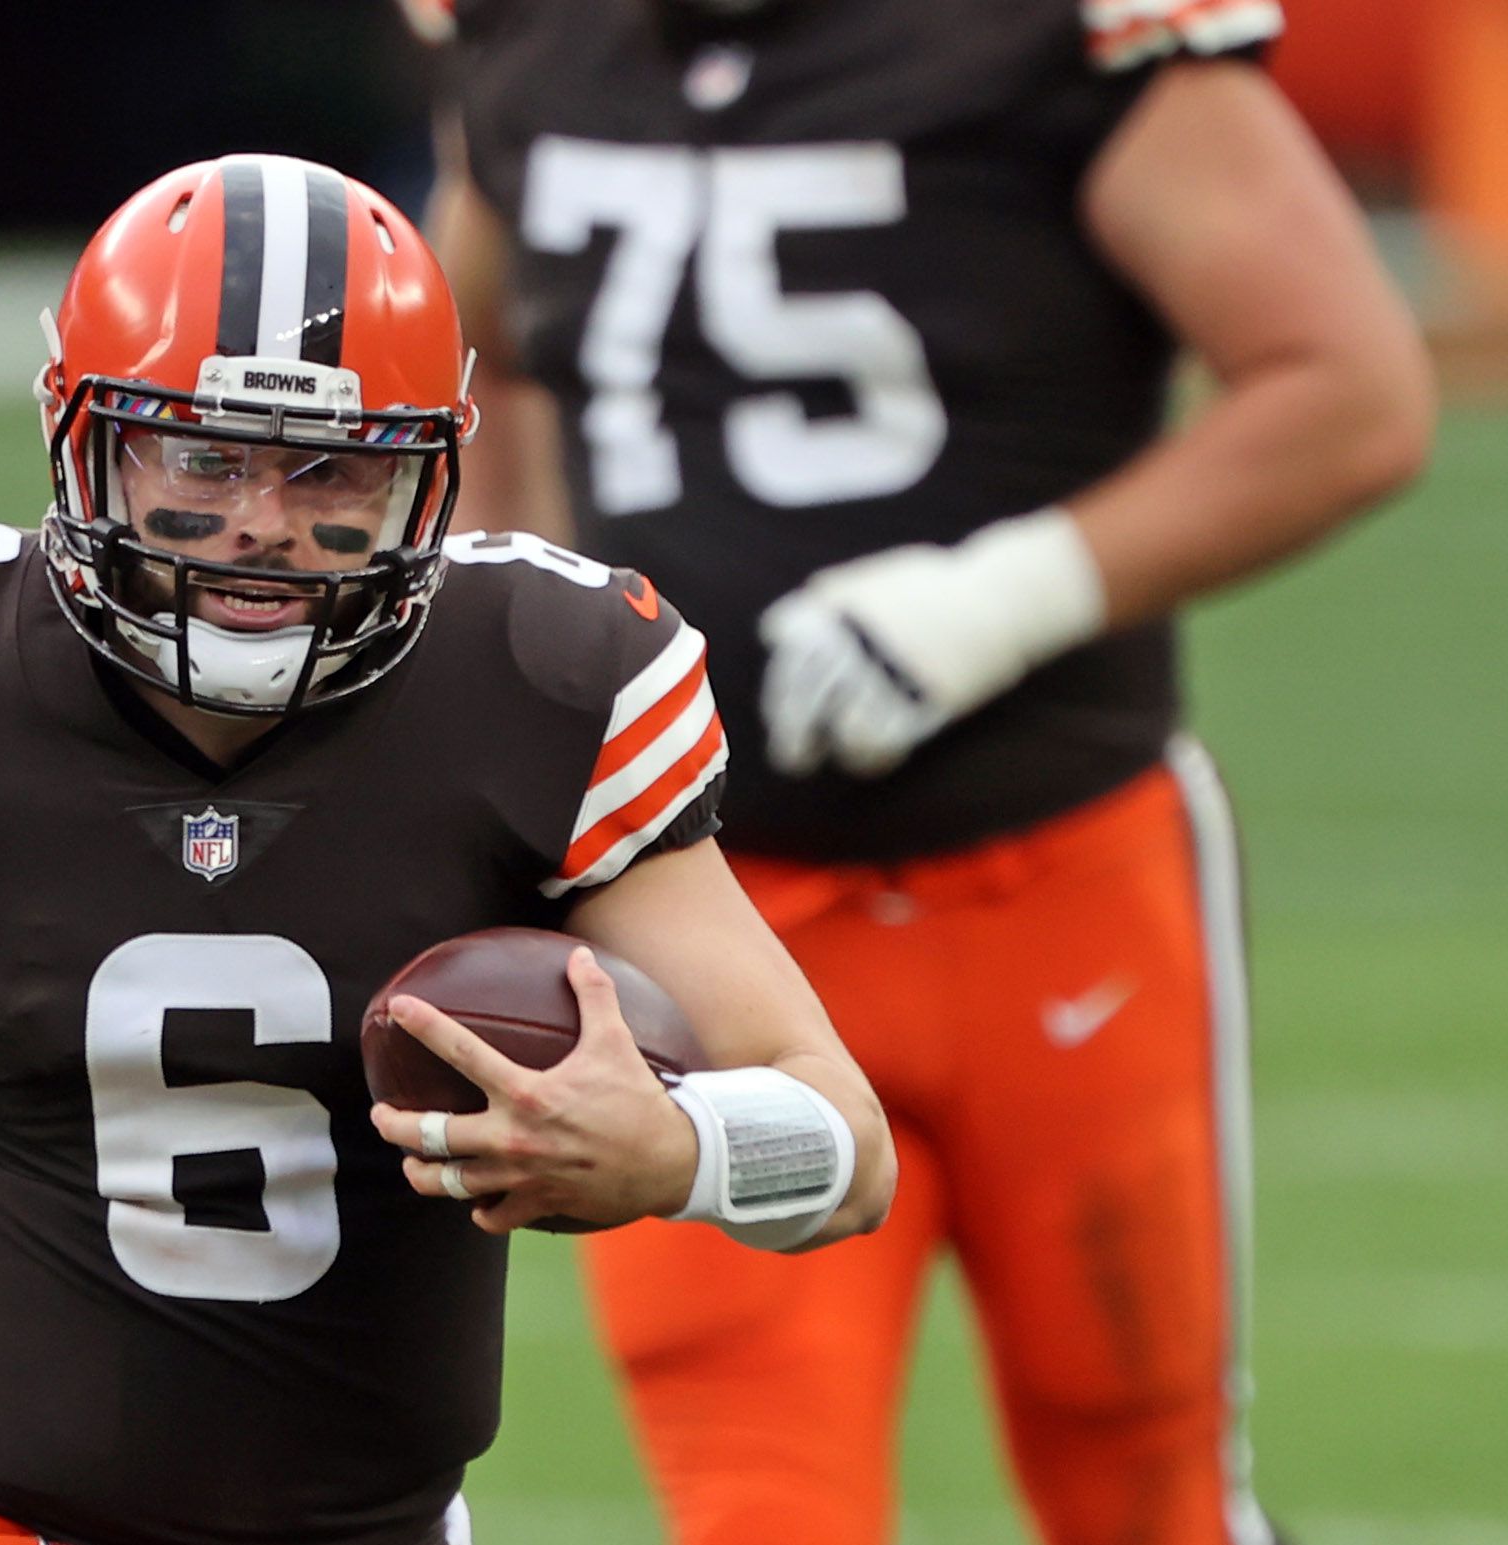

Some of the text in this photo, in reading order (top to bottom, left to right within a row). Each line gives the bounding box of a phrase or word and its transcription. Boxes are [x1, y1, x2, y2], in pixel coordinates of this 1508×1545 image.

[243, 370, 317, 395] BROWNS
[521, 132, 949, 517] 75
[192, 841, 230, 868] NFL
[85, 932, 342, 1304] 6
